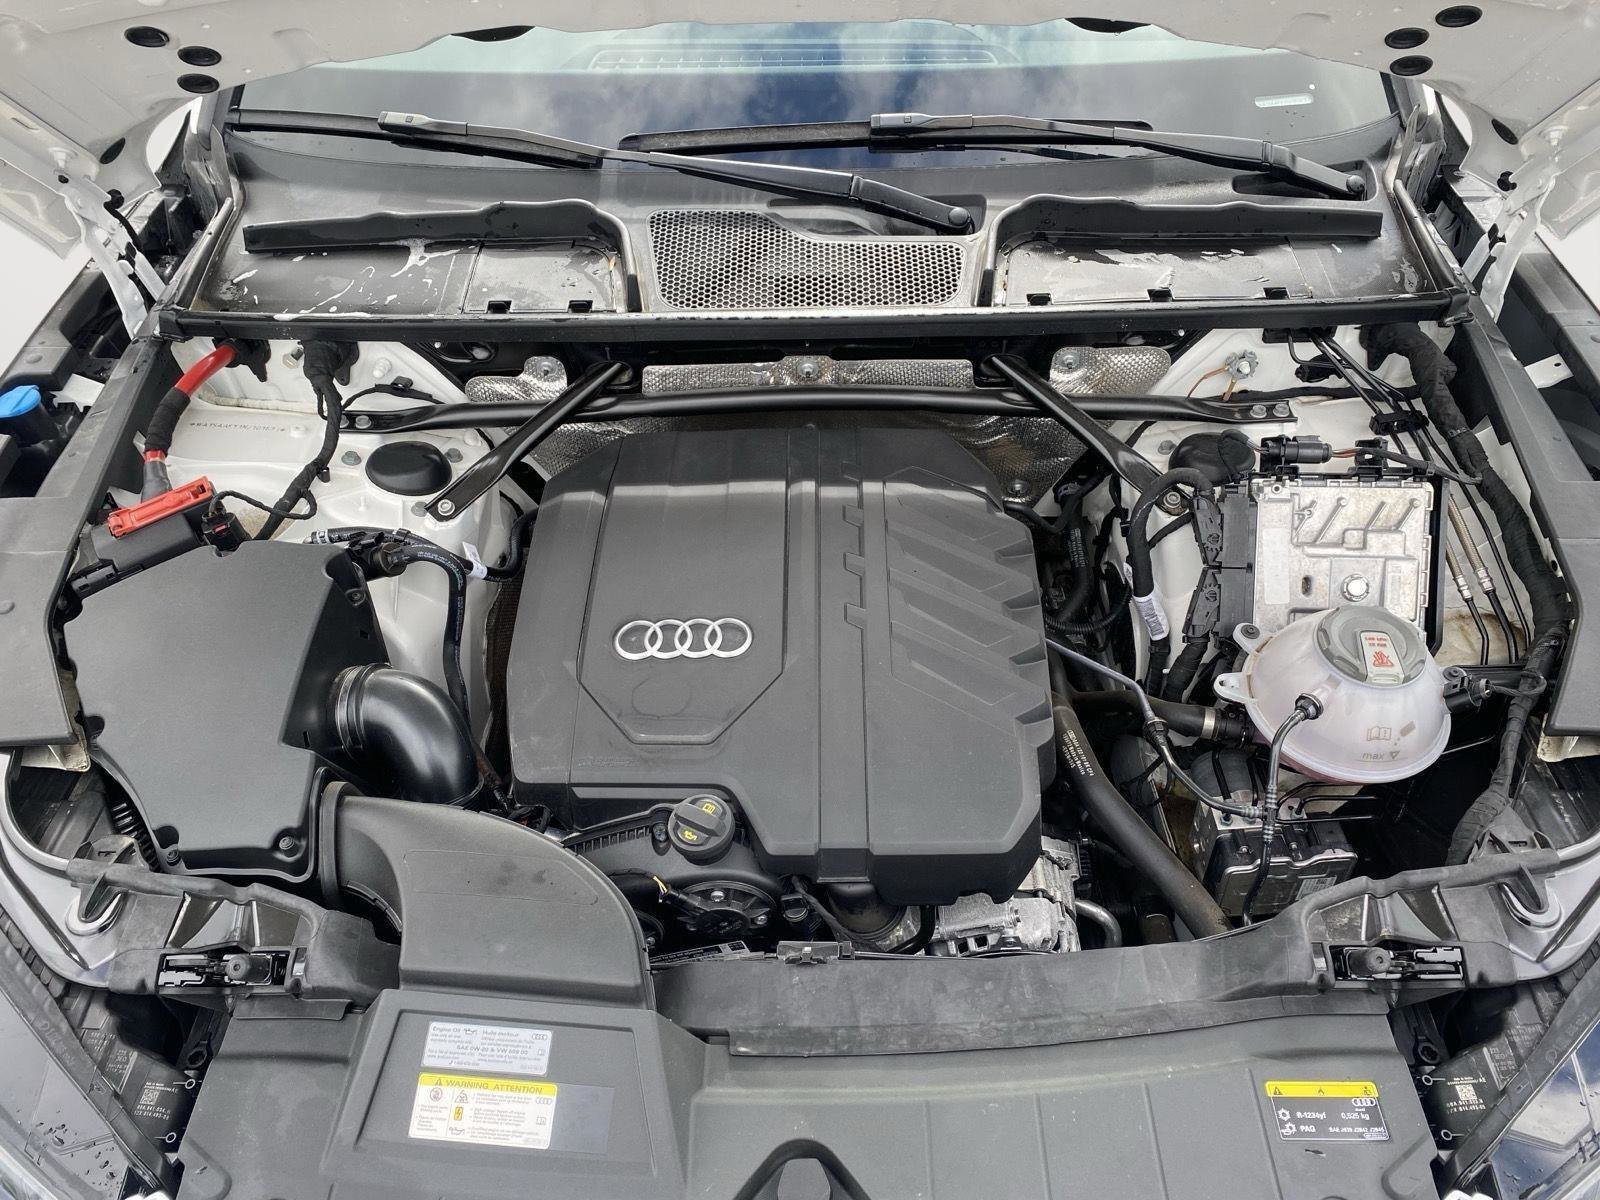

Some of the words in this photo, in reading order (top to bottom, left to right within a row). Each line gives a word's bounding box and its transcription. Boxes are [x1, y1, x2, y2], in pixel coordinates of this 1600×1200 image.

[1362, 752, 1385, 761] max
[446, 1080, 490, 1091] WARNING
[494, 1084, 543, 1095] ATTENTION
[1361, 1112, 1370, 1121] kg
